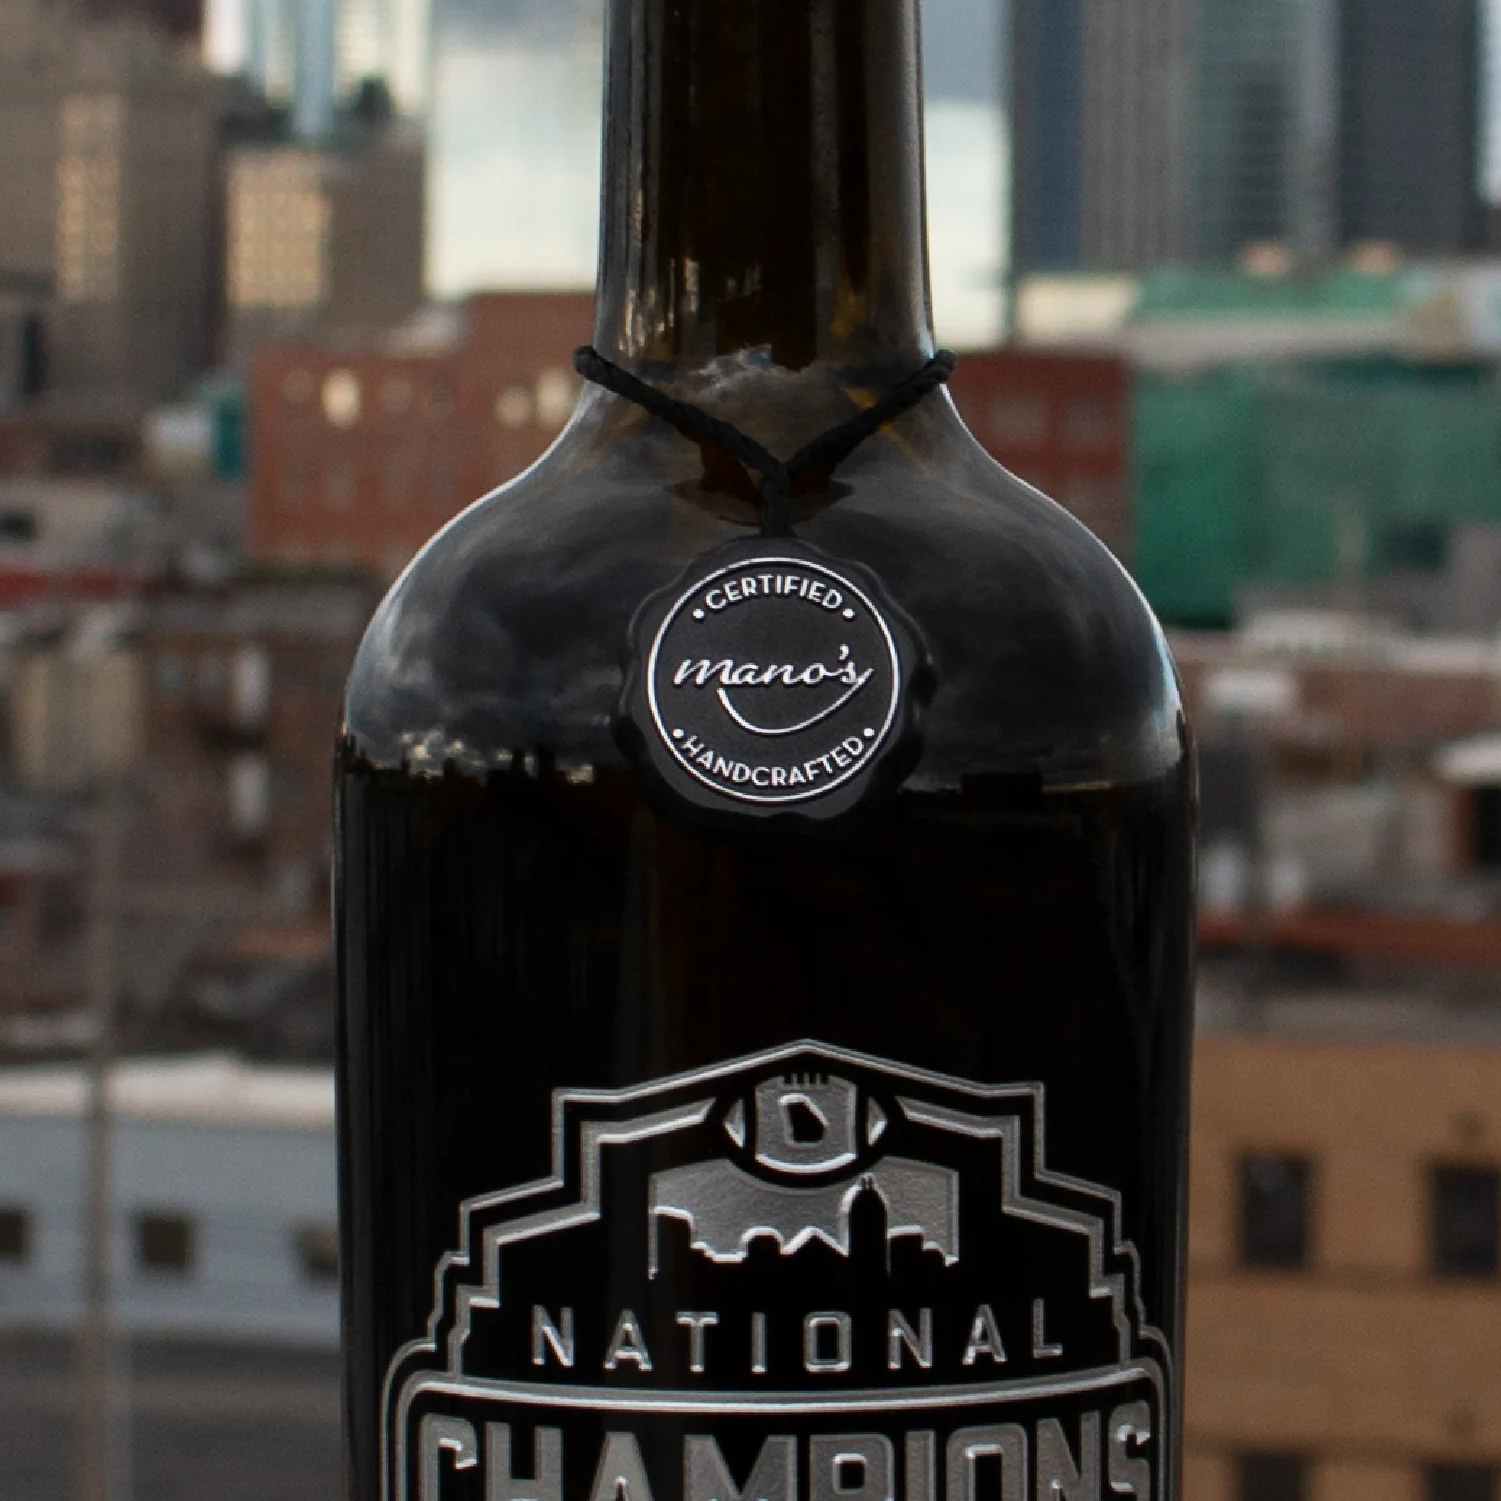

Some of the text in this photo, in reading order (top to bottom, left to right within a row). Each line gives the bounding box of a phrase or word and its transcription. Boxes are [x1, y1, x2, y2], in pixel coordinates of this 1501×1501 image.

[705, 573, 844, 611] CERTIFIED
[680, 735, 865, 788] HANDCRAFTED
[531, 1299, 1064, 1373] NATIONAL
